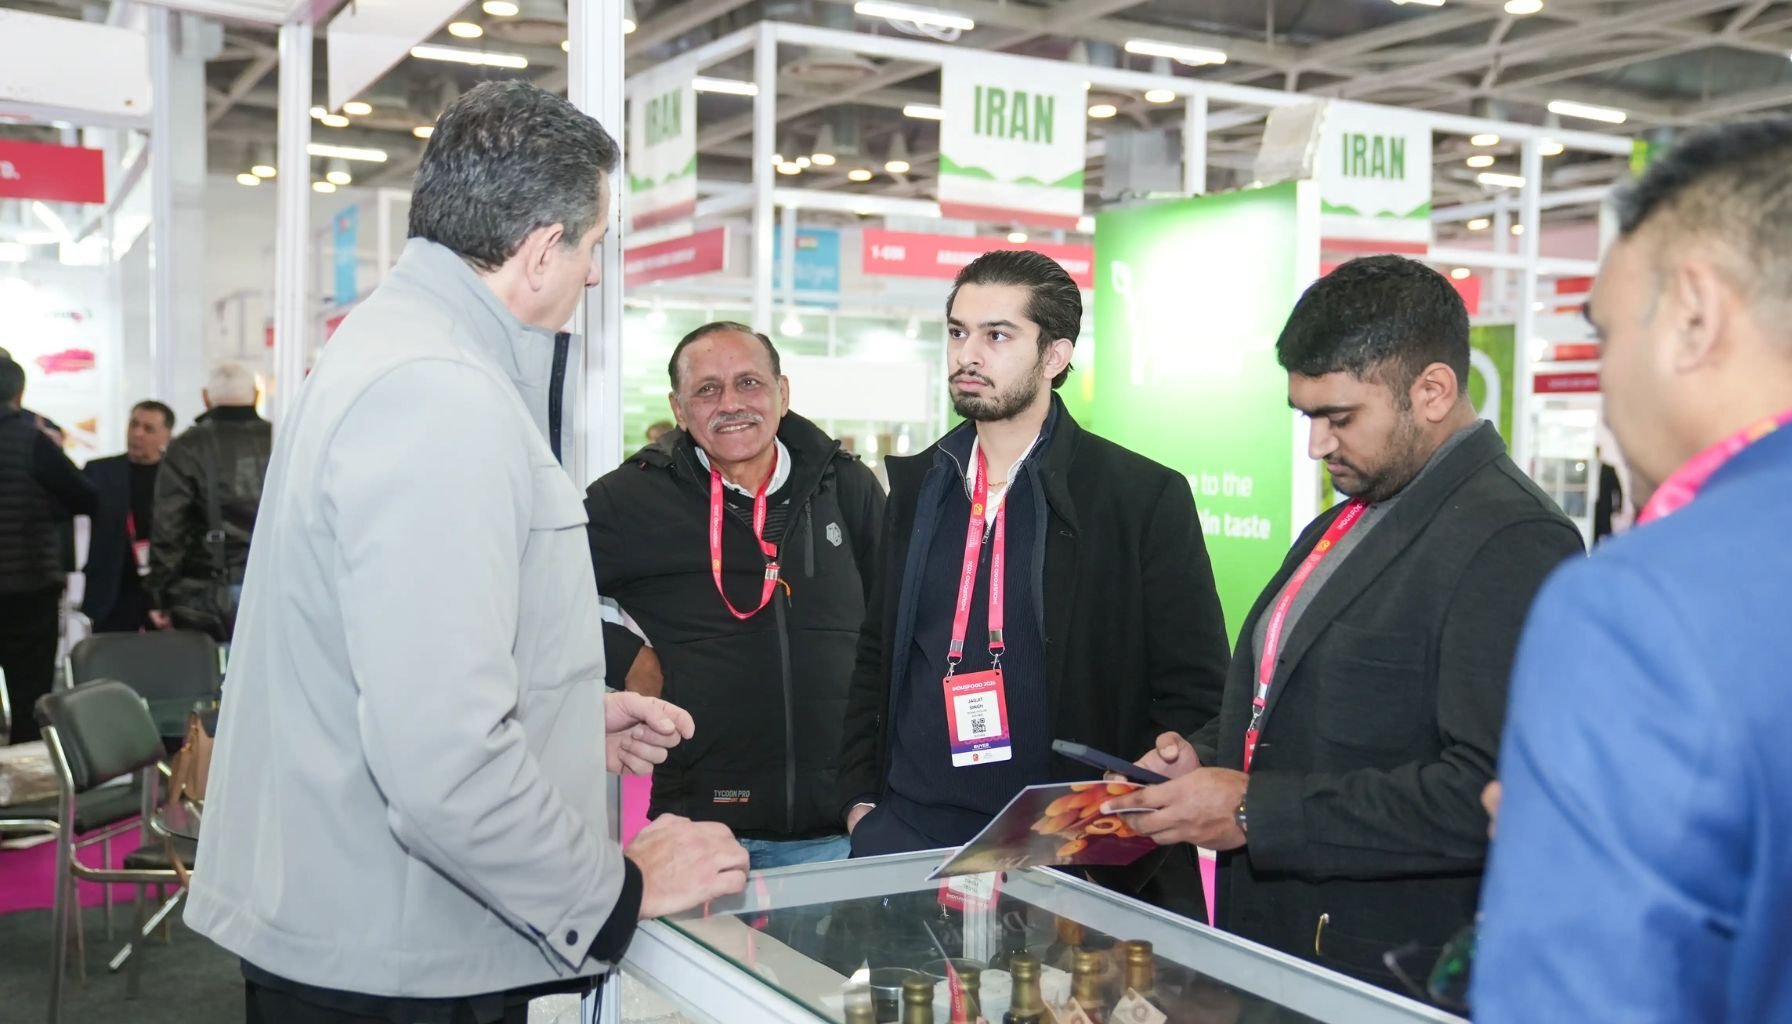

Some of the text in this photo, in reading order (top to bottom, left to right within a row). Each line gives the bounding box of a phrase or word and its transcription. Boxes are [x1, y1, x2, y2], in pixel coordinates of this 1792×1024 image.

[644, 87, 682, 147] IRAN
[973, 84, 1054, 145] IRAN
[1342, 132, 1404, 180] IRAN
[1201, 471, 1218, 496] to
[1223, 472, 1253, 497] the
[1223, 512, 1270, 539] taste
[960, 575, 971, 612] INDUSFOOD
[952, 682, 983, 692] INDUSFOOD
[714, 789, 751, 798] TYCOON PRO
